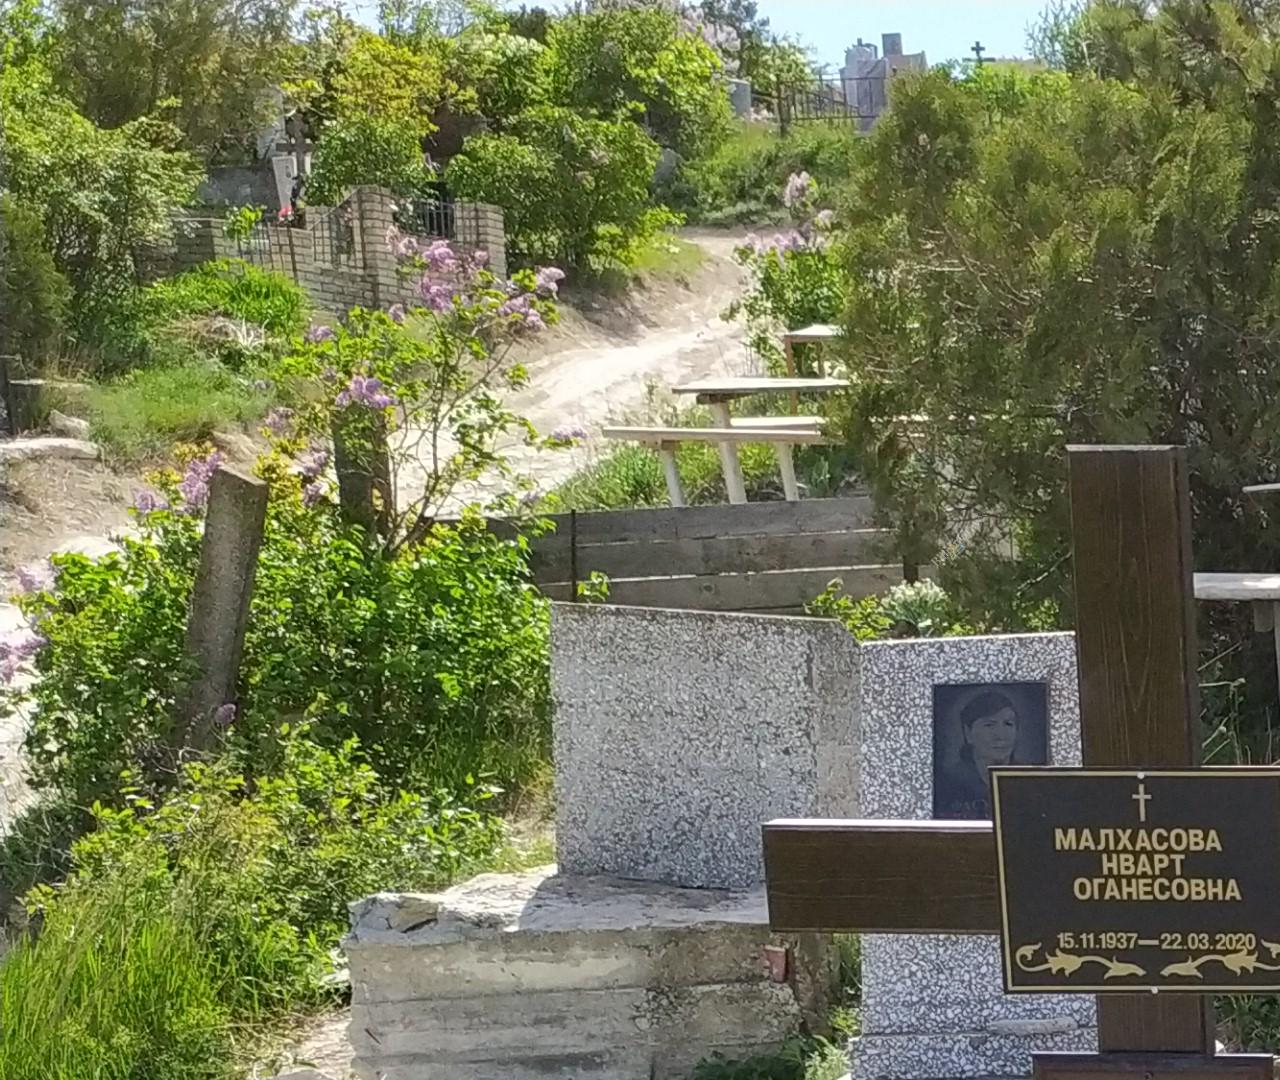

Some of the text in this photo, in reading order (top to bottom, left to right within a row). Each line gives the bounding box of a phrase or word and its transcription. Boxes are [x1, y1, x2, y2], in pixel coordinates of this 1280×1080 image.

[1055, 828, 1223, 851] МАЛХАСОВА
[1101, 853, 1186, 876] НВАРТ
[1073, 877, 1242, 901] ОГАНЕСОВНА
